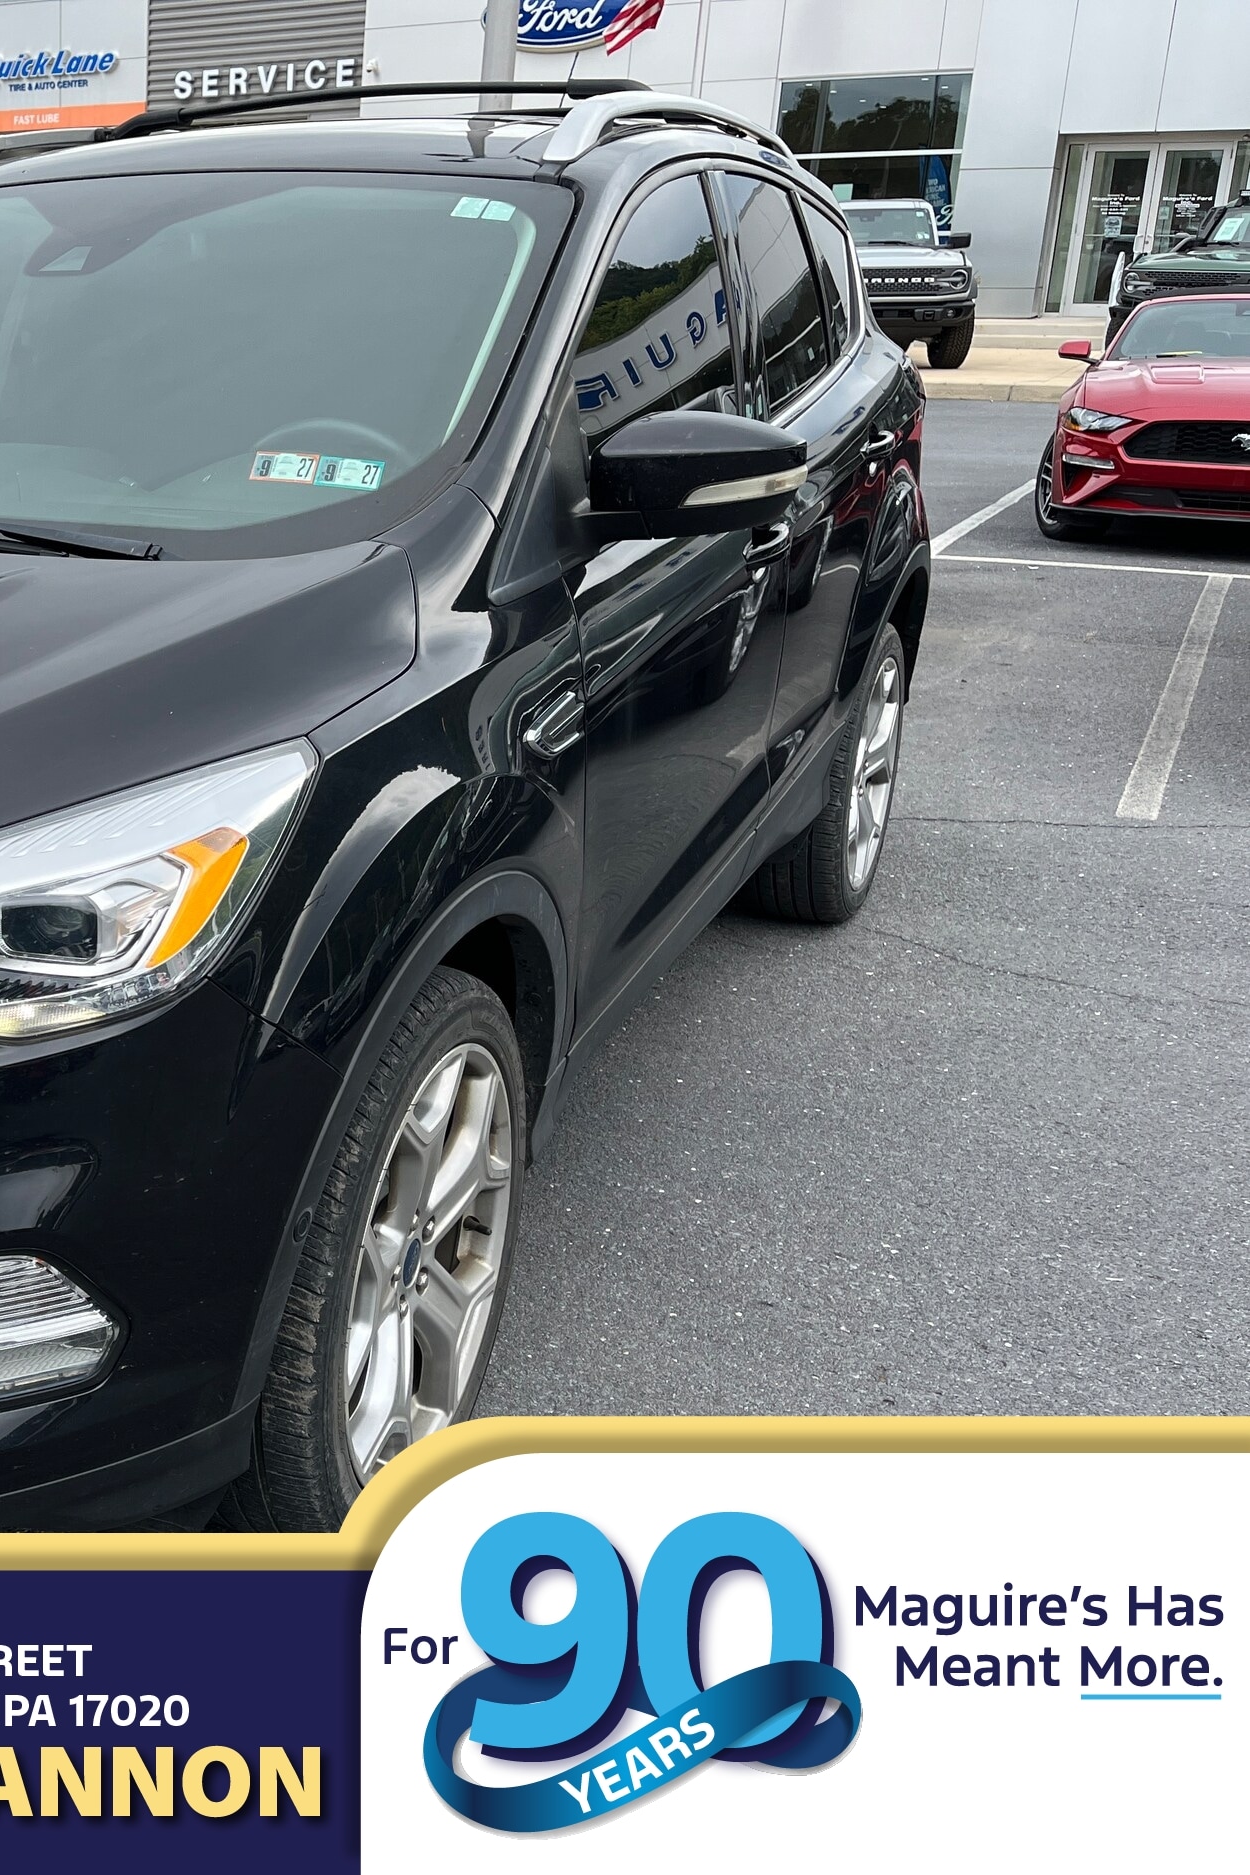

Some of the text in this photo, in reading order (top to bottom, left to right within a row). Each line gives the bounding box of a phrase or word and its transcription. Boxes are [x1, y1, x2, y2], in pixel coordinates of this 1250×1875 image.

[51, 50, 115, 76] Lane
[8, 80, 89, 92] TIRE & AUTO CENTER
[174, 59, 356, 100] SERVICE
[14, 113, 60, 125] FAST LUBE
[260, 460, 271, 477] 9
[296, 458, 314, 479] 27
[324, 464, 337, 482] 9
[361, 464, 379, 485] 27
